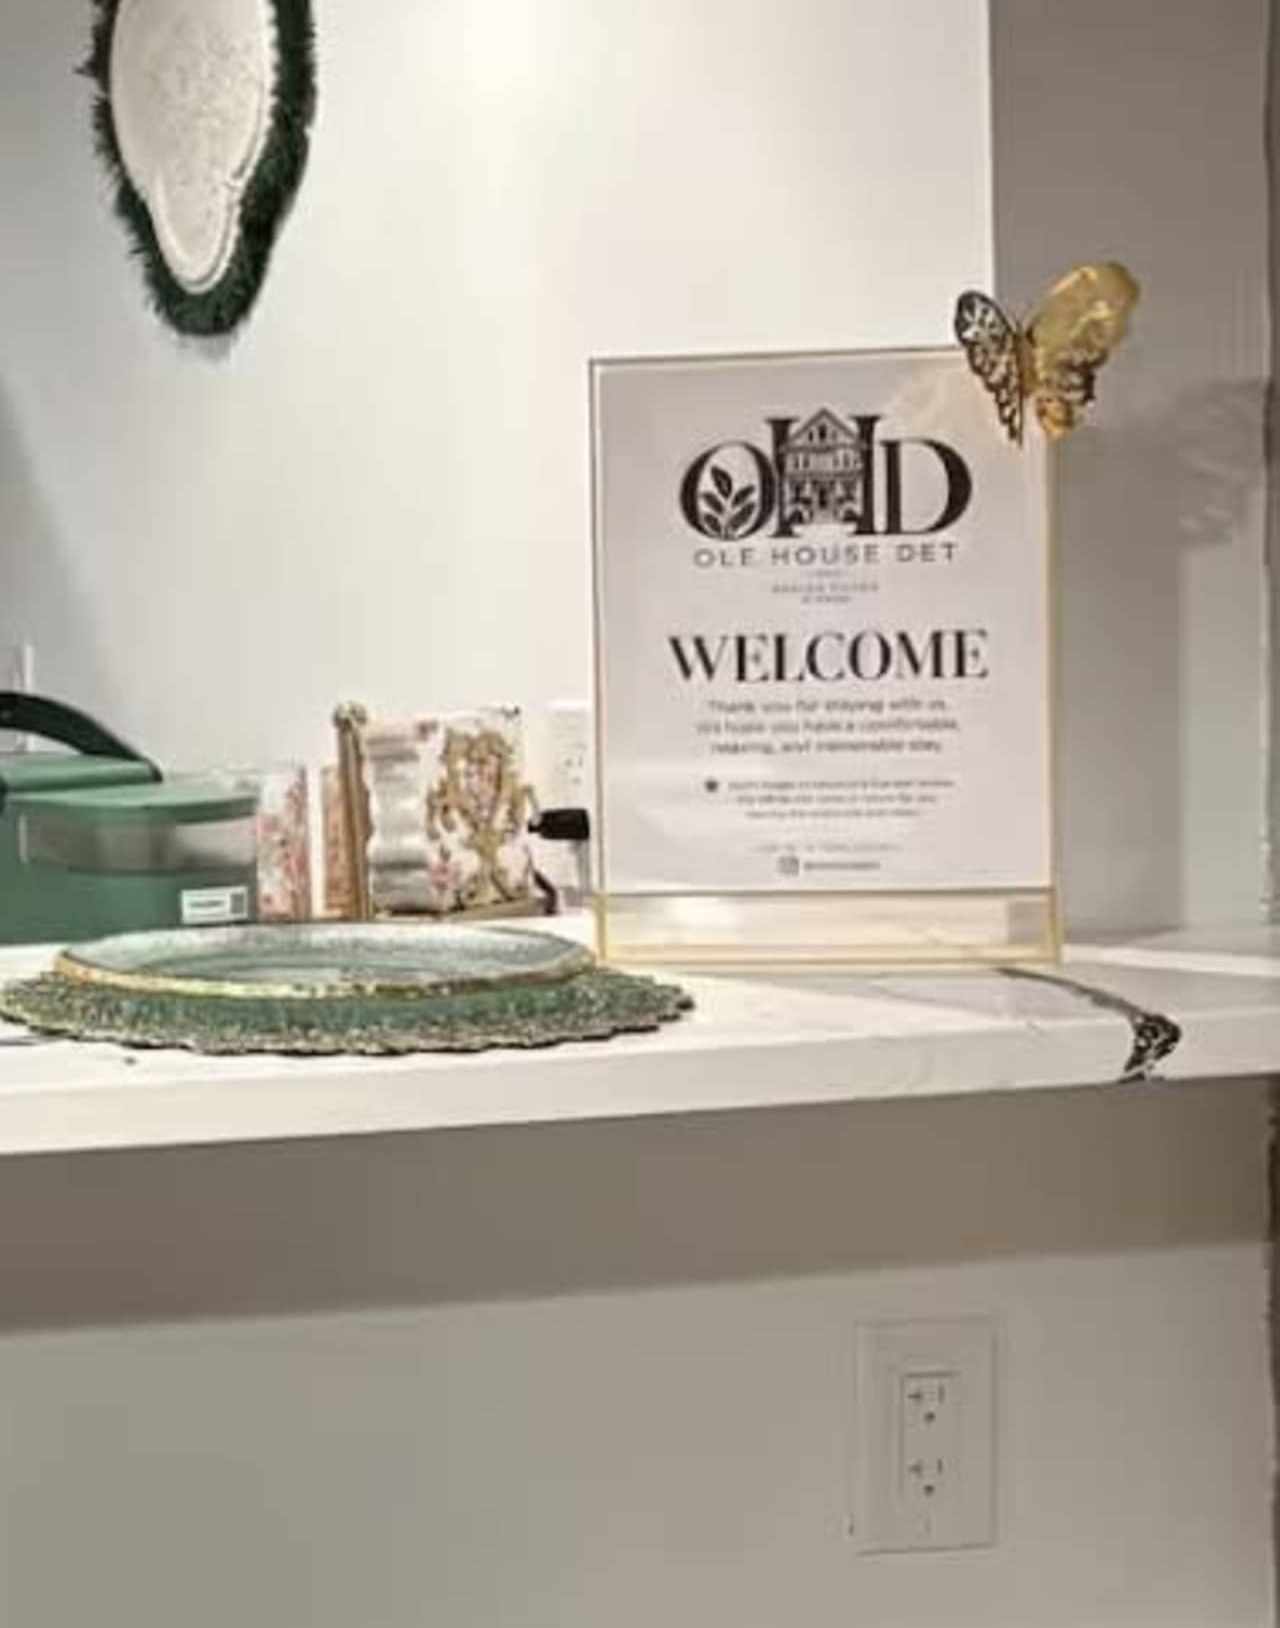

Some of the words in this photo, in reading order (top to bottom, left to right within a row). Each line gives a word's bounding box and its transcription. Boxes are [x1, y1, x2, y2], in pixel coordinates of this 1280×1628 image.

[693, 547, 756, 568] OLE
[771, 544, 881, 566] HOUSE
[896, 541, 959, 563] DET
[668, 628, 989, 682] WELCOME
